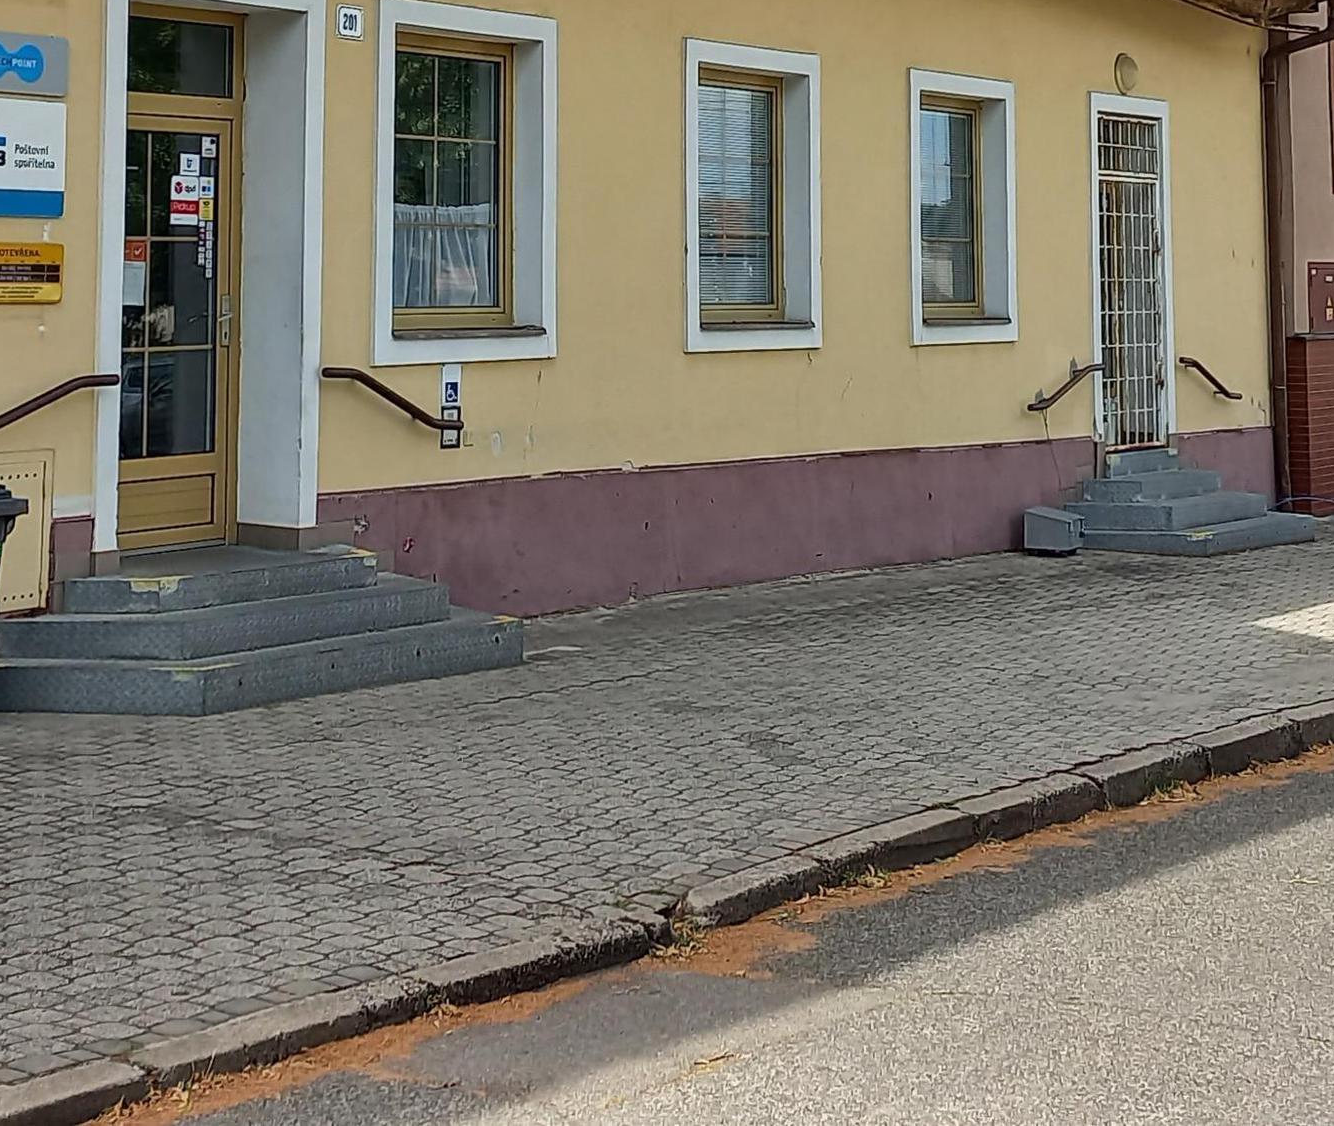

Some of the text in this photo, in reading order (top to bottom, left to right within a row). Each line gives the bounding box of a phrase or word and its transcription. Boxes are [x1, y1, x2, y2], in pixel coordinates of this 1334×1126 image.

[342, 12, 358, 33] 201
[14, 143, 49, 156] Poštovní
[14, 157, 55, 170] spořitelna
[184, 183, 197, 194] dpd
